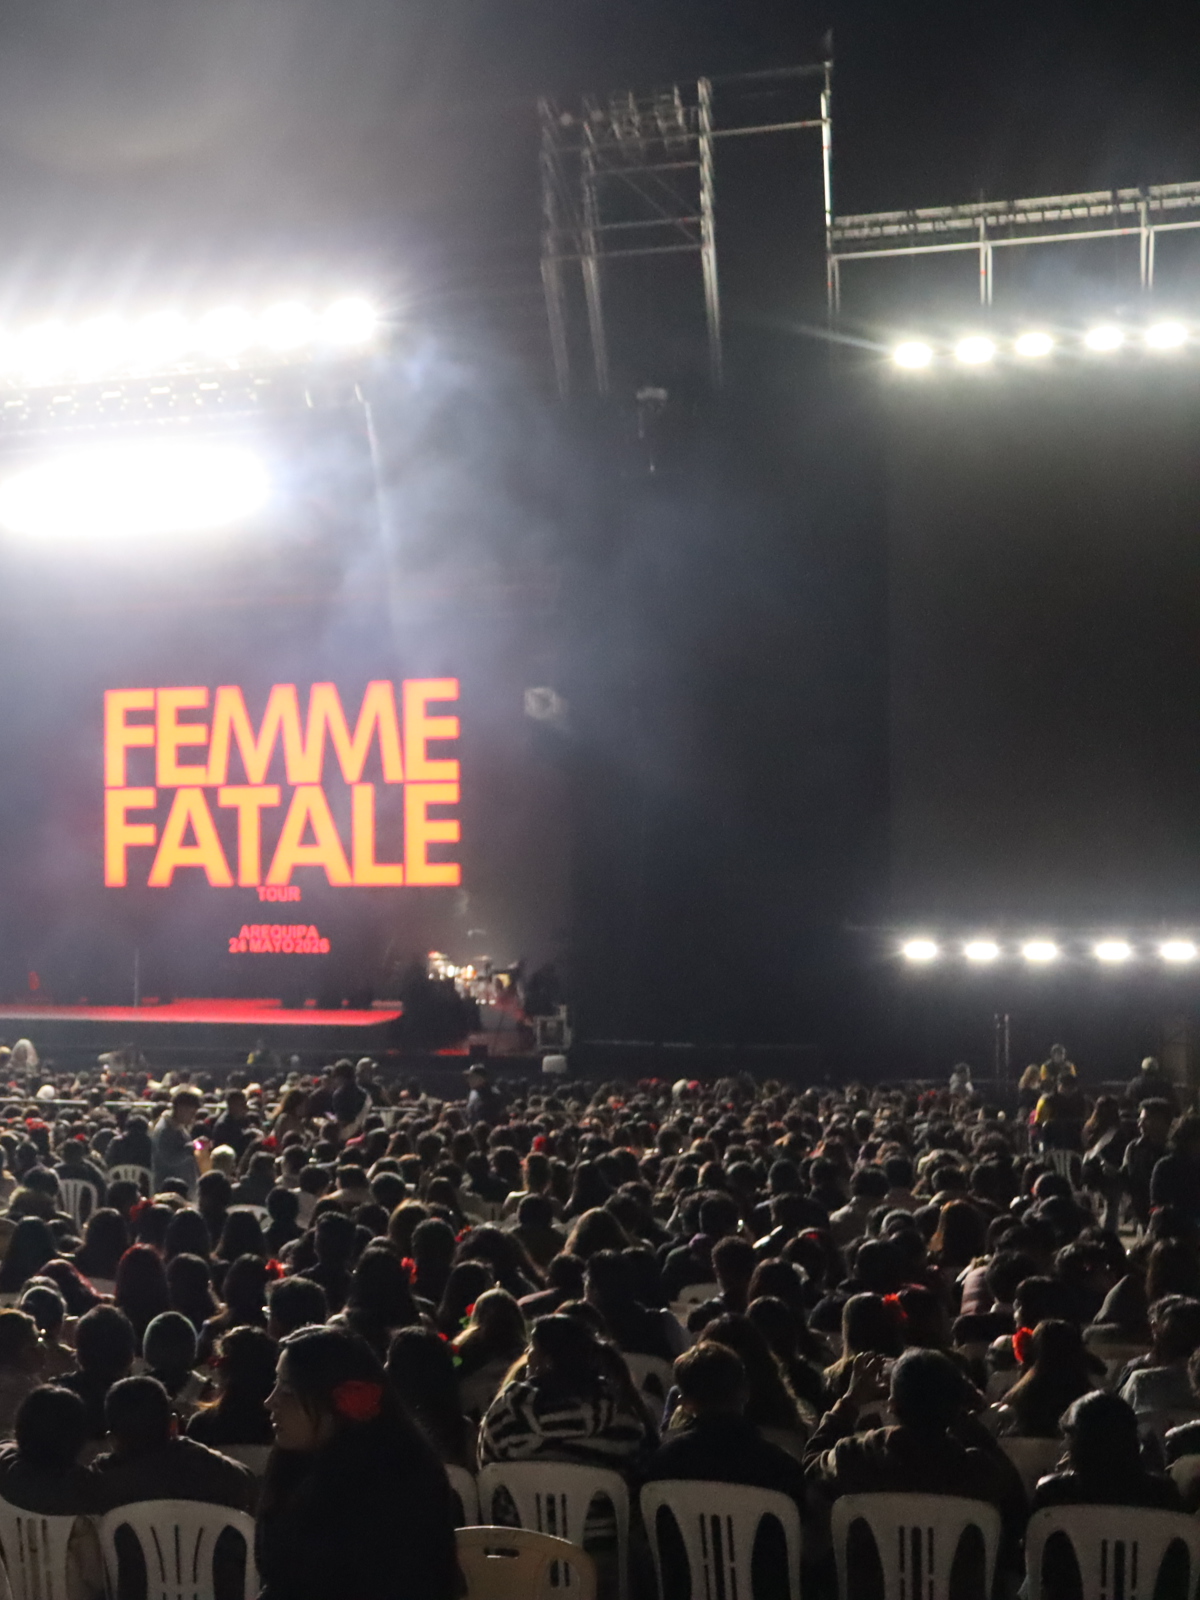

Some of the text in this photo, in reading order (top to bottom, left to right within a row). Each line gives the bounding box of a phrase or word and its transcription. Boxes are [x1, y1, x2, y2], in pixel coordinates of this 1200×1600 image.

[104, 678, 460, 788] FEMME
[104, 781, 461, 887] FATALE
[256, 886, 301, 902] TOUR
[239, 924, 319, 939] AREQUIPA
